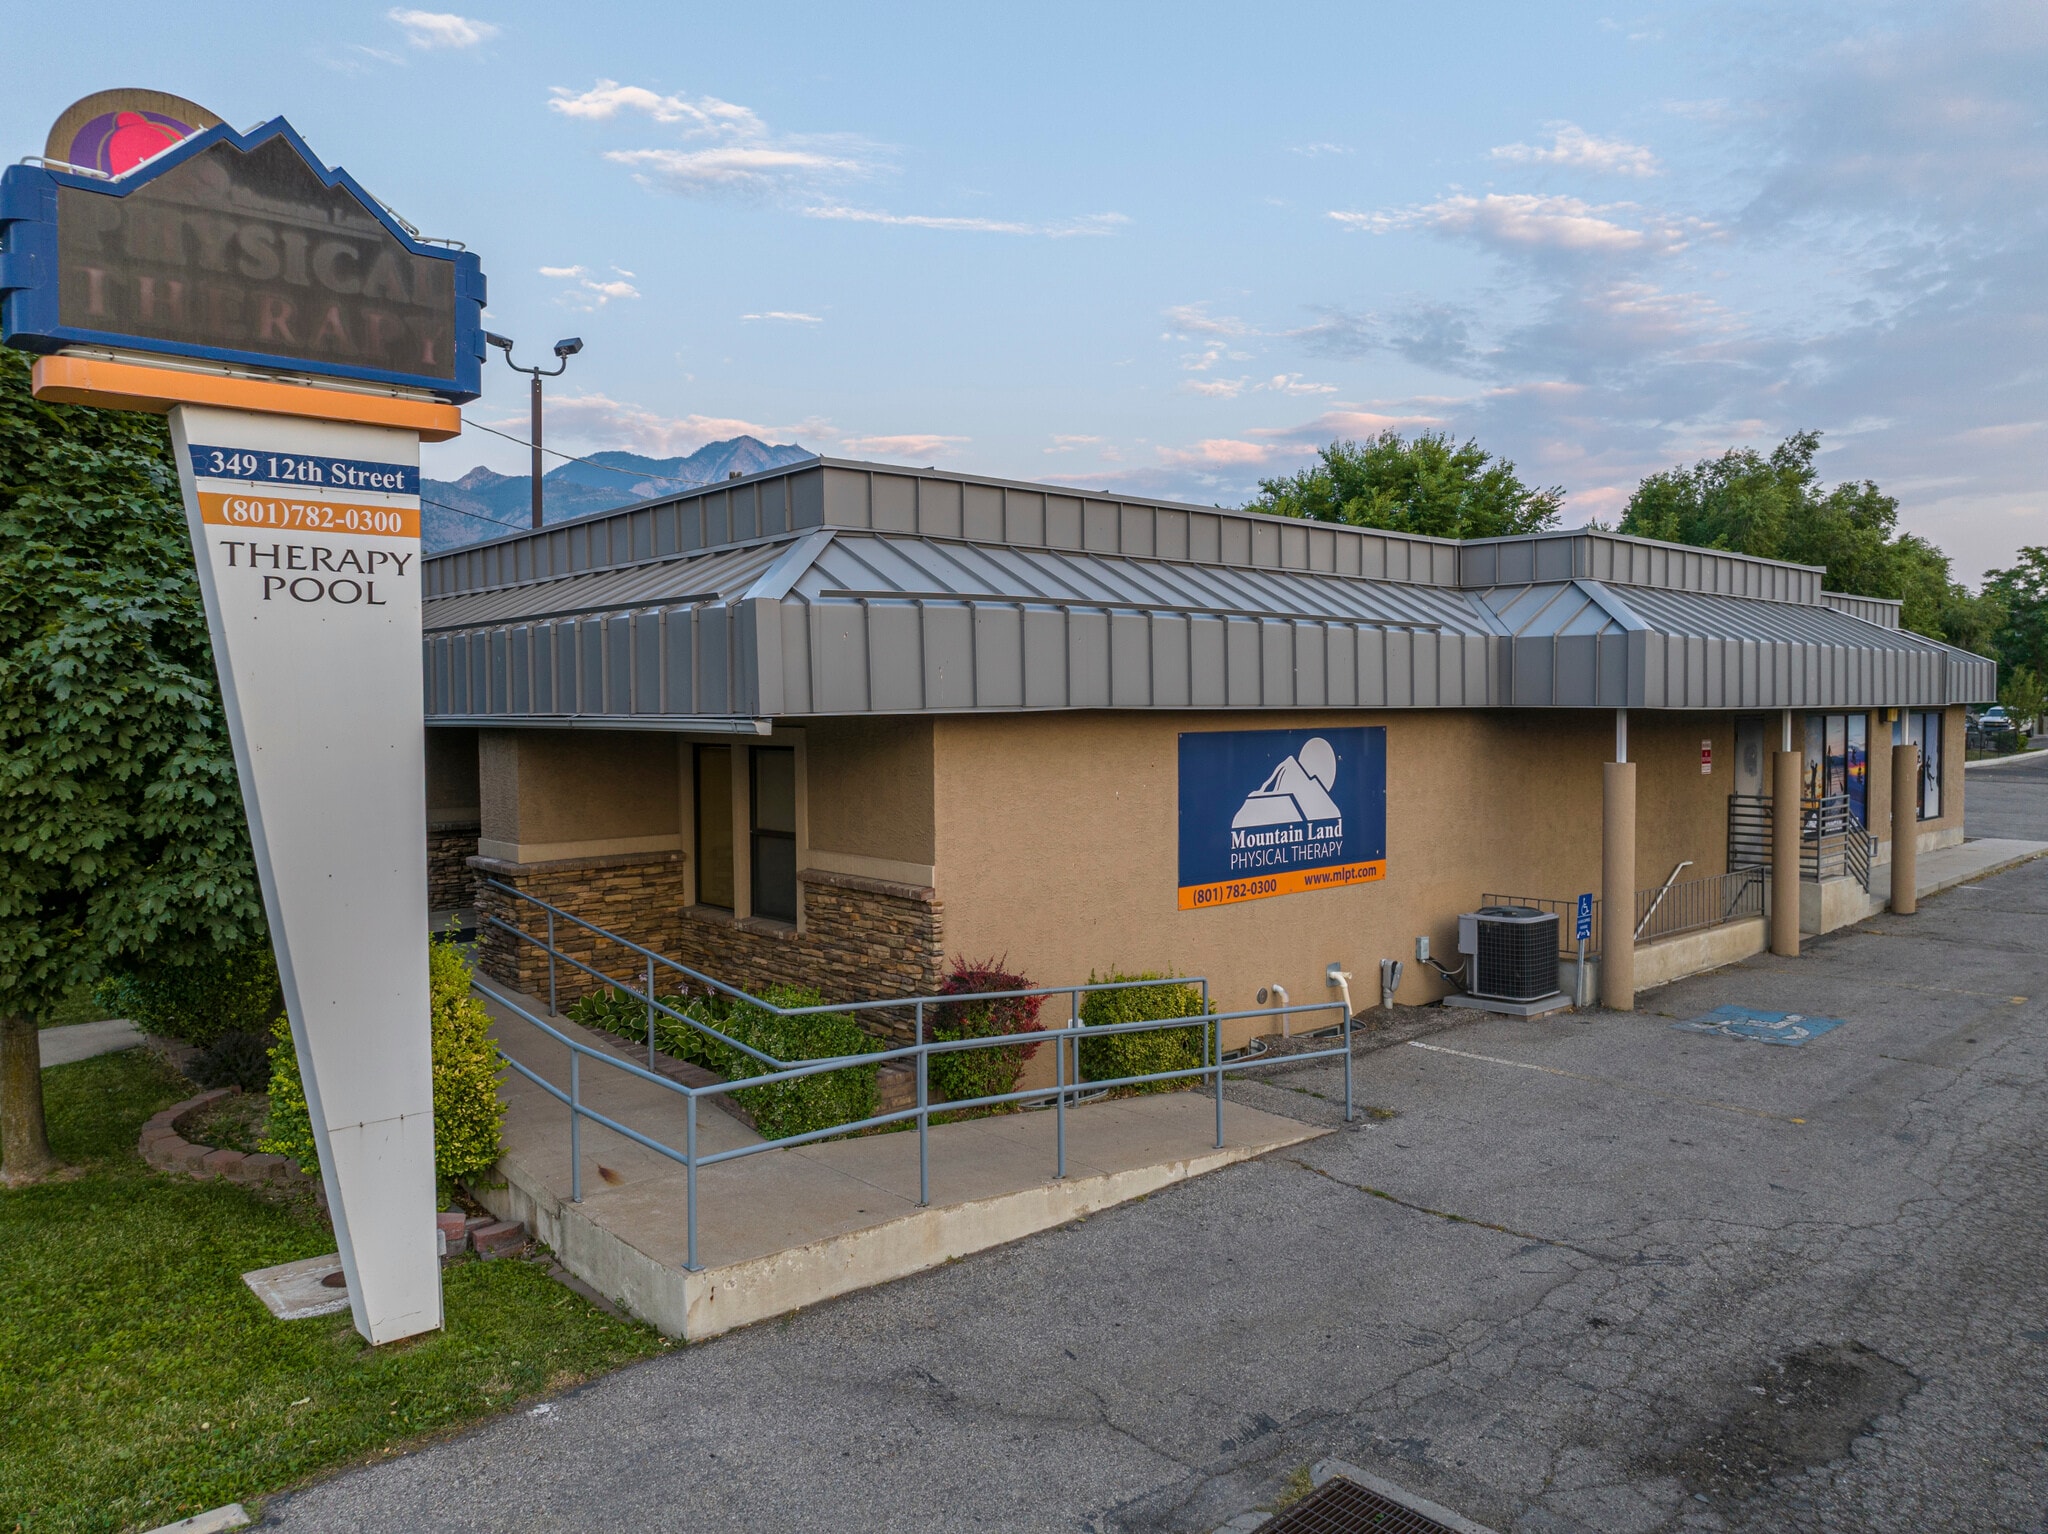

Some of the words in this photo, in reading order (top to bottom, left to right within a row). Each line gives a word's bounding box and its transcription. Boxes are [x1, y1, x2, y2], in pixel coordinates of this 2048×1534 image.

[71, 199, 453, 312] PHYSICAL
[72, 265, 447, 366] THERAPY
[209, 451, 258, 476] 349
[267, 457, 323, 483] 12th
[331, 463, 405, 490] Street
[222, 497, 402, 533] (801)782-0300
[220, 541, 413, 576] THERAPY
[263, 575, 387, 605] POOL
[1231, 825, 1304, 850] Mountain
[1307, 819, 1343, 841] Land
[1230, 847, 1289, 870] PHYSICAL
[1291, 841, 1344, 862] THERAPY
[1304, 865, 1377, 886] www.mlpt.com
[1193, 886, 1223, 906] (801)
[1226, 879, 1277, 899] 782-0300
